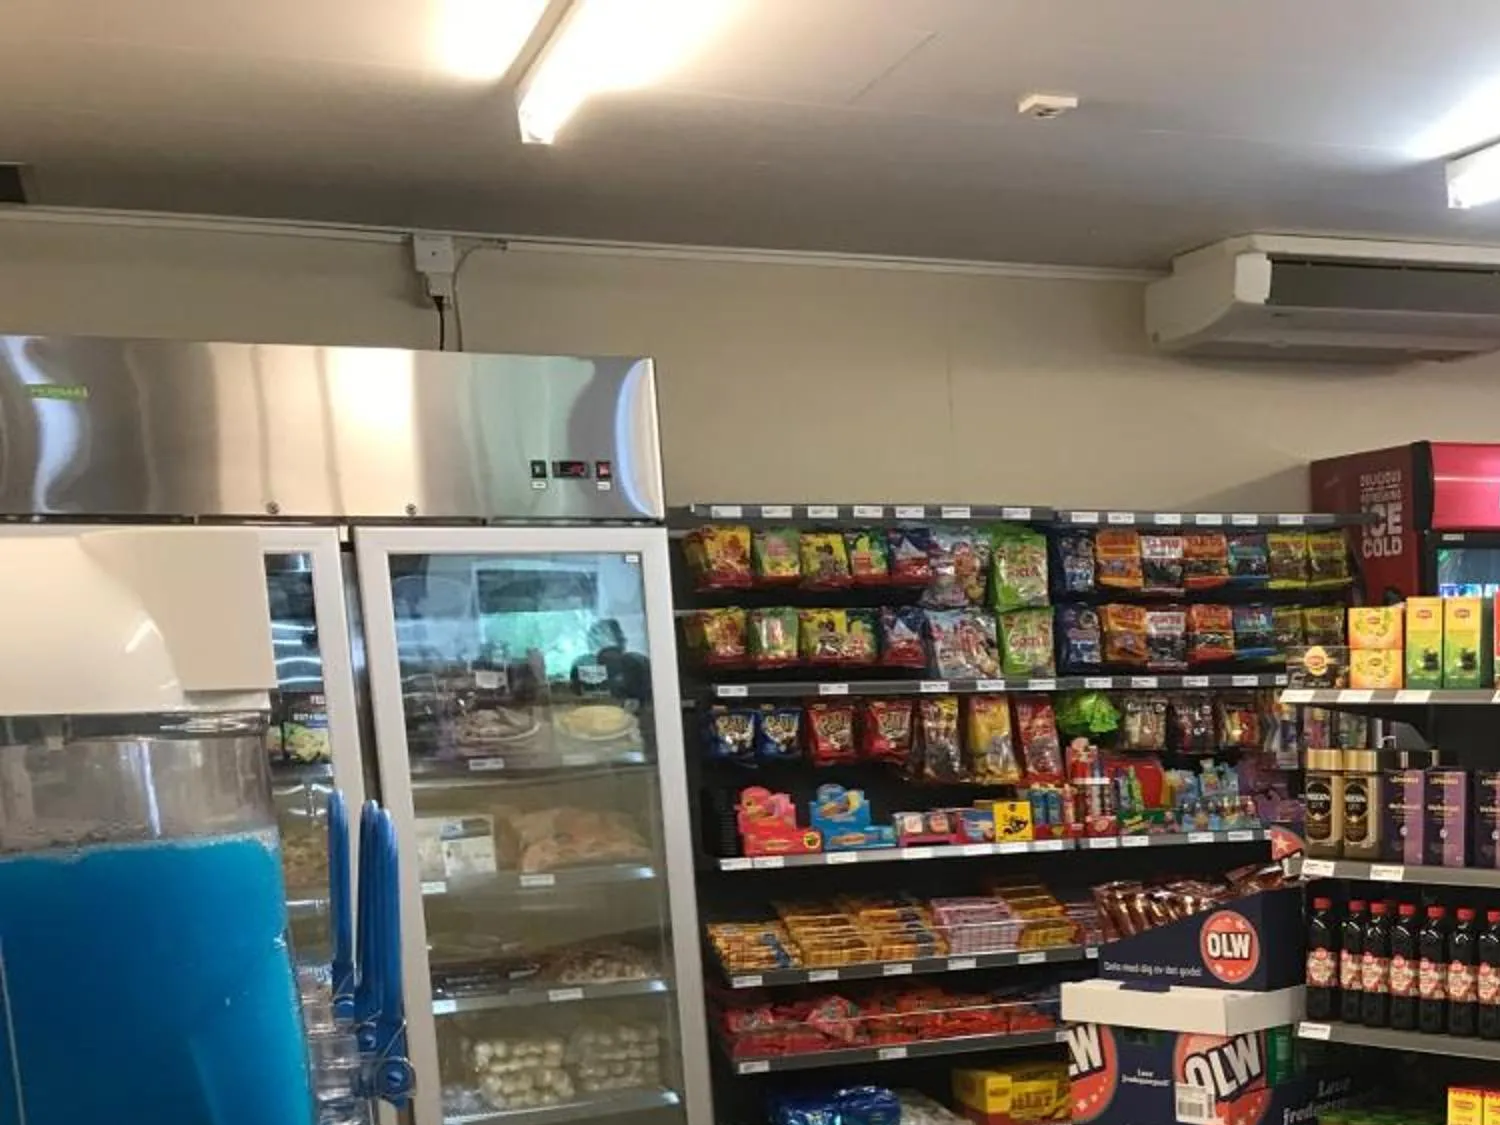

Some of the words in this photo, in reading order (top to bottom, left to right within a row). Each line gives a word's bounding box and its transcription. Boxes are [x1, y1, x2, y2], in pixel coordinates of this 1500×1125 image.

[1362, 536, 1402, 559] COLD
[1206, 931, 1250, 960] OLW
[1185, 1032, 1264, 1099] OLW
